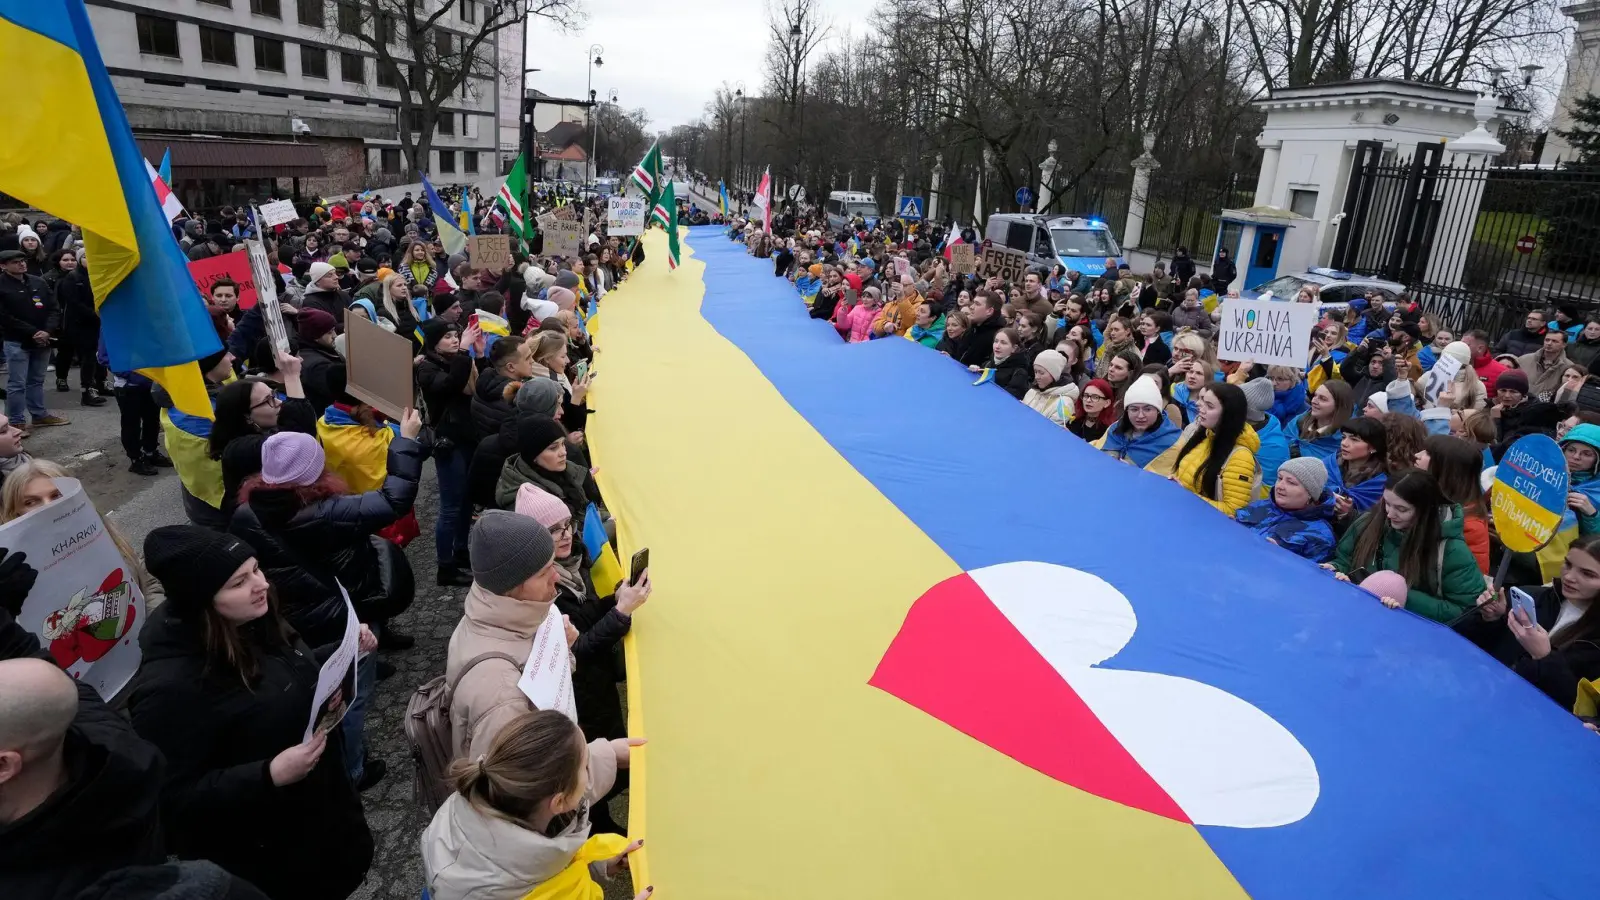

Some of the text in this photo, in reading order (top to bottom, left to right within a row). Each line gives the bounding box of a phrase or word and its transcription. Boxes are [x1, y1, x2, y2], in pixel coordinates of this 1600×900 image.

[547, 221, 558, 231] BE
[477, 237, 506, 251] FREE
[477, 252, 508, 263] AZOV
[985, 250, 1022, 269] FREE
[984, 264, 1022, 283] AZOV
[1234, 309, 1290, 333] WOLNA
[1225, 331, 1292, 358] UKRAINA
[1513, 476, 1541, 502] БУТИ
[51, 522, 97, 555] KHARKIV
